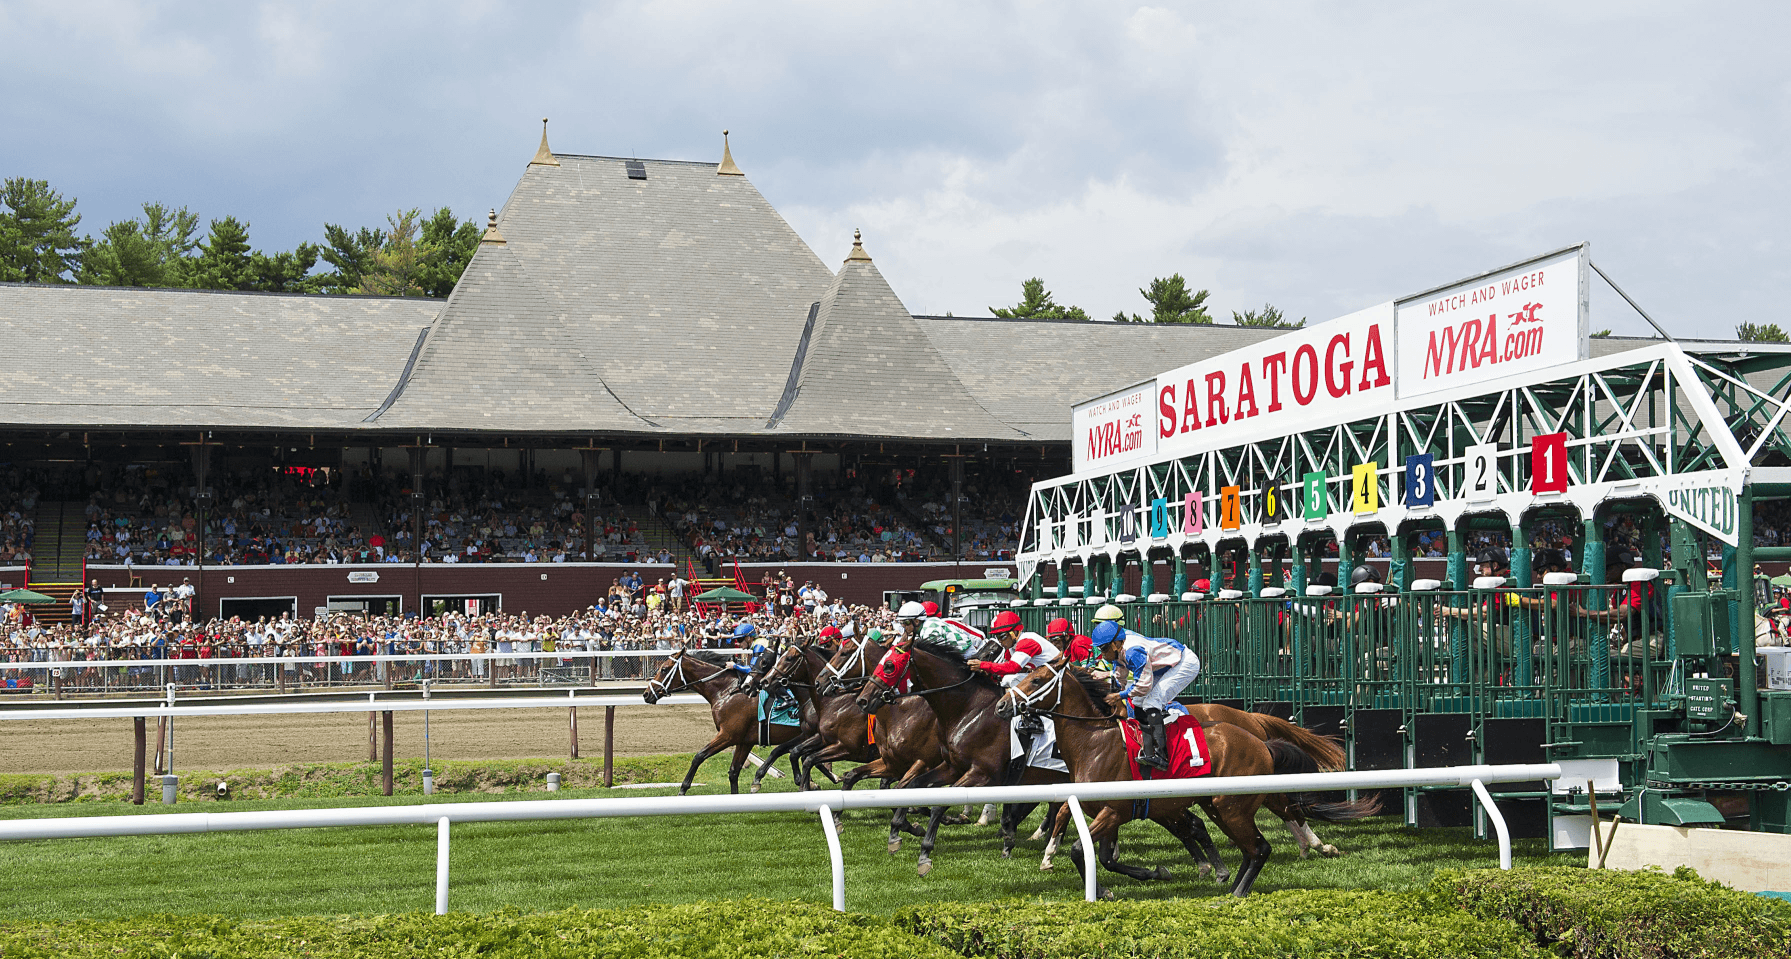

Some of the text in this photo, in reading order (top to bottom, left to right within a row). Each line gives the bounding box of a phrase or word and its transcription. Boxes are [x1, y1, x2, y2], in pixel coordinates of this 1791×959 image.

[1428, 271, 1545, 317] WATCH AND WAGER
[1423, 313, 1544, 380] NYRA.com
[1159, 323, 1391, 439] SARATOGA
[1088, 393, 1142, 419] WATCH AND WAGER
[1086, 418, 1143, 462] NYRA.com
[1414, 463, 1426, 499] 3
[1475, 455, 1487, 491] 2
[1543, 443, 1554, 484] 1
[1266, 486, 1276, 517] 6
[1311, 479, 1321, 512] 5
[1360, 472, 1370, 504] 4
[1122, 509, 1134, 537] 10
[1156, 504, 1164, 532] 9
[1190, 499, 1198, 527] 8
[1227, 493, 1235, 522] 7
[1668, 485, 1735, 536] UNITED
[1183, 727, 1204, 768] 1
